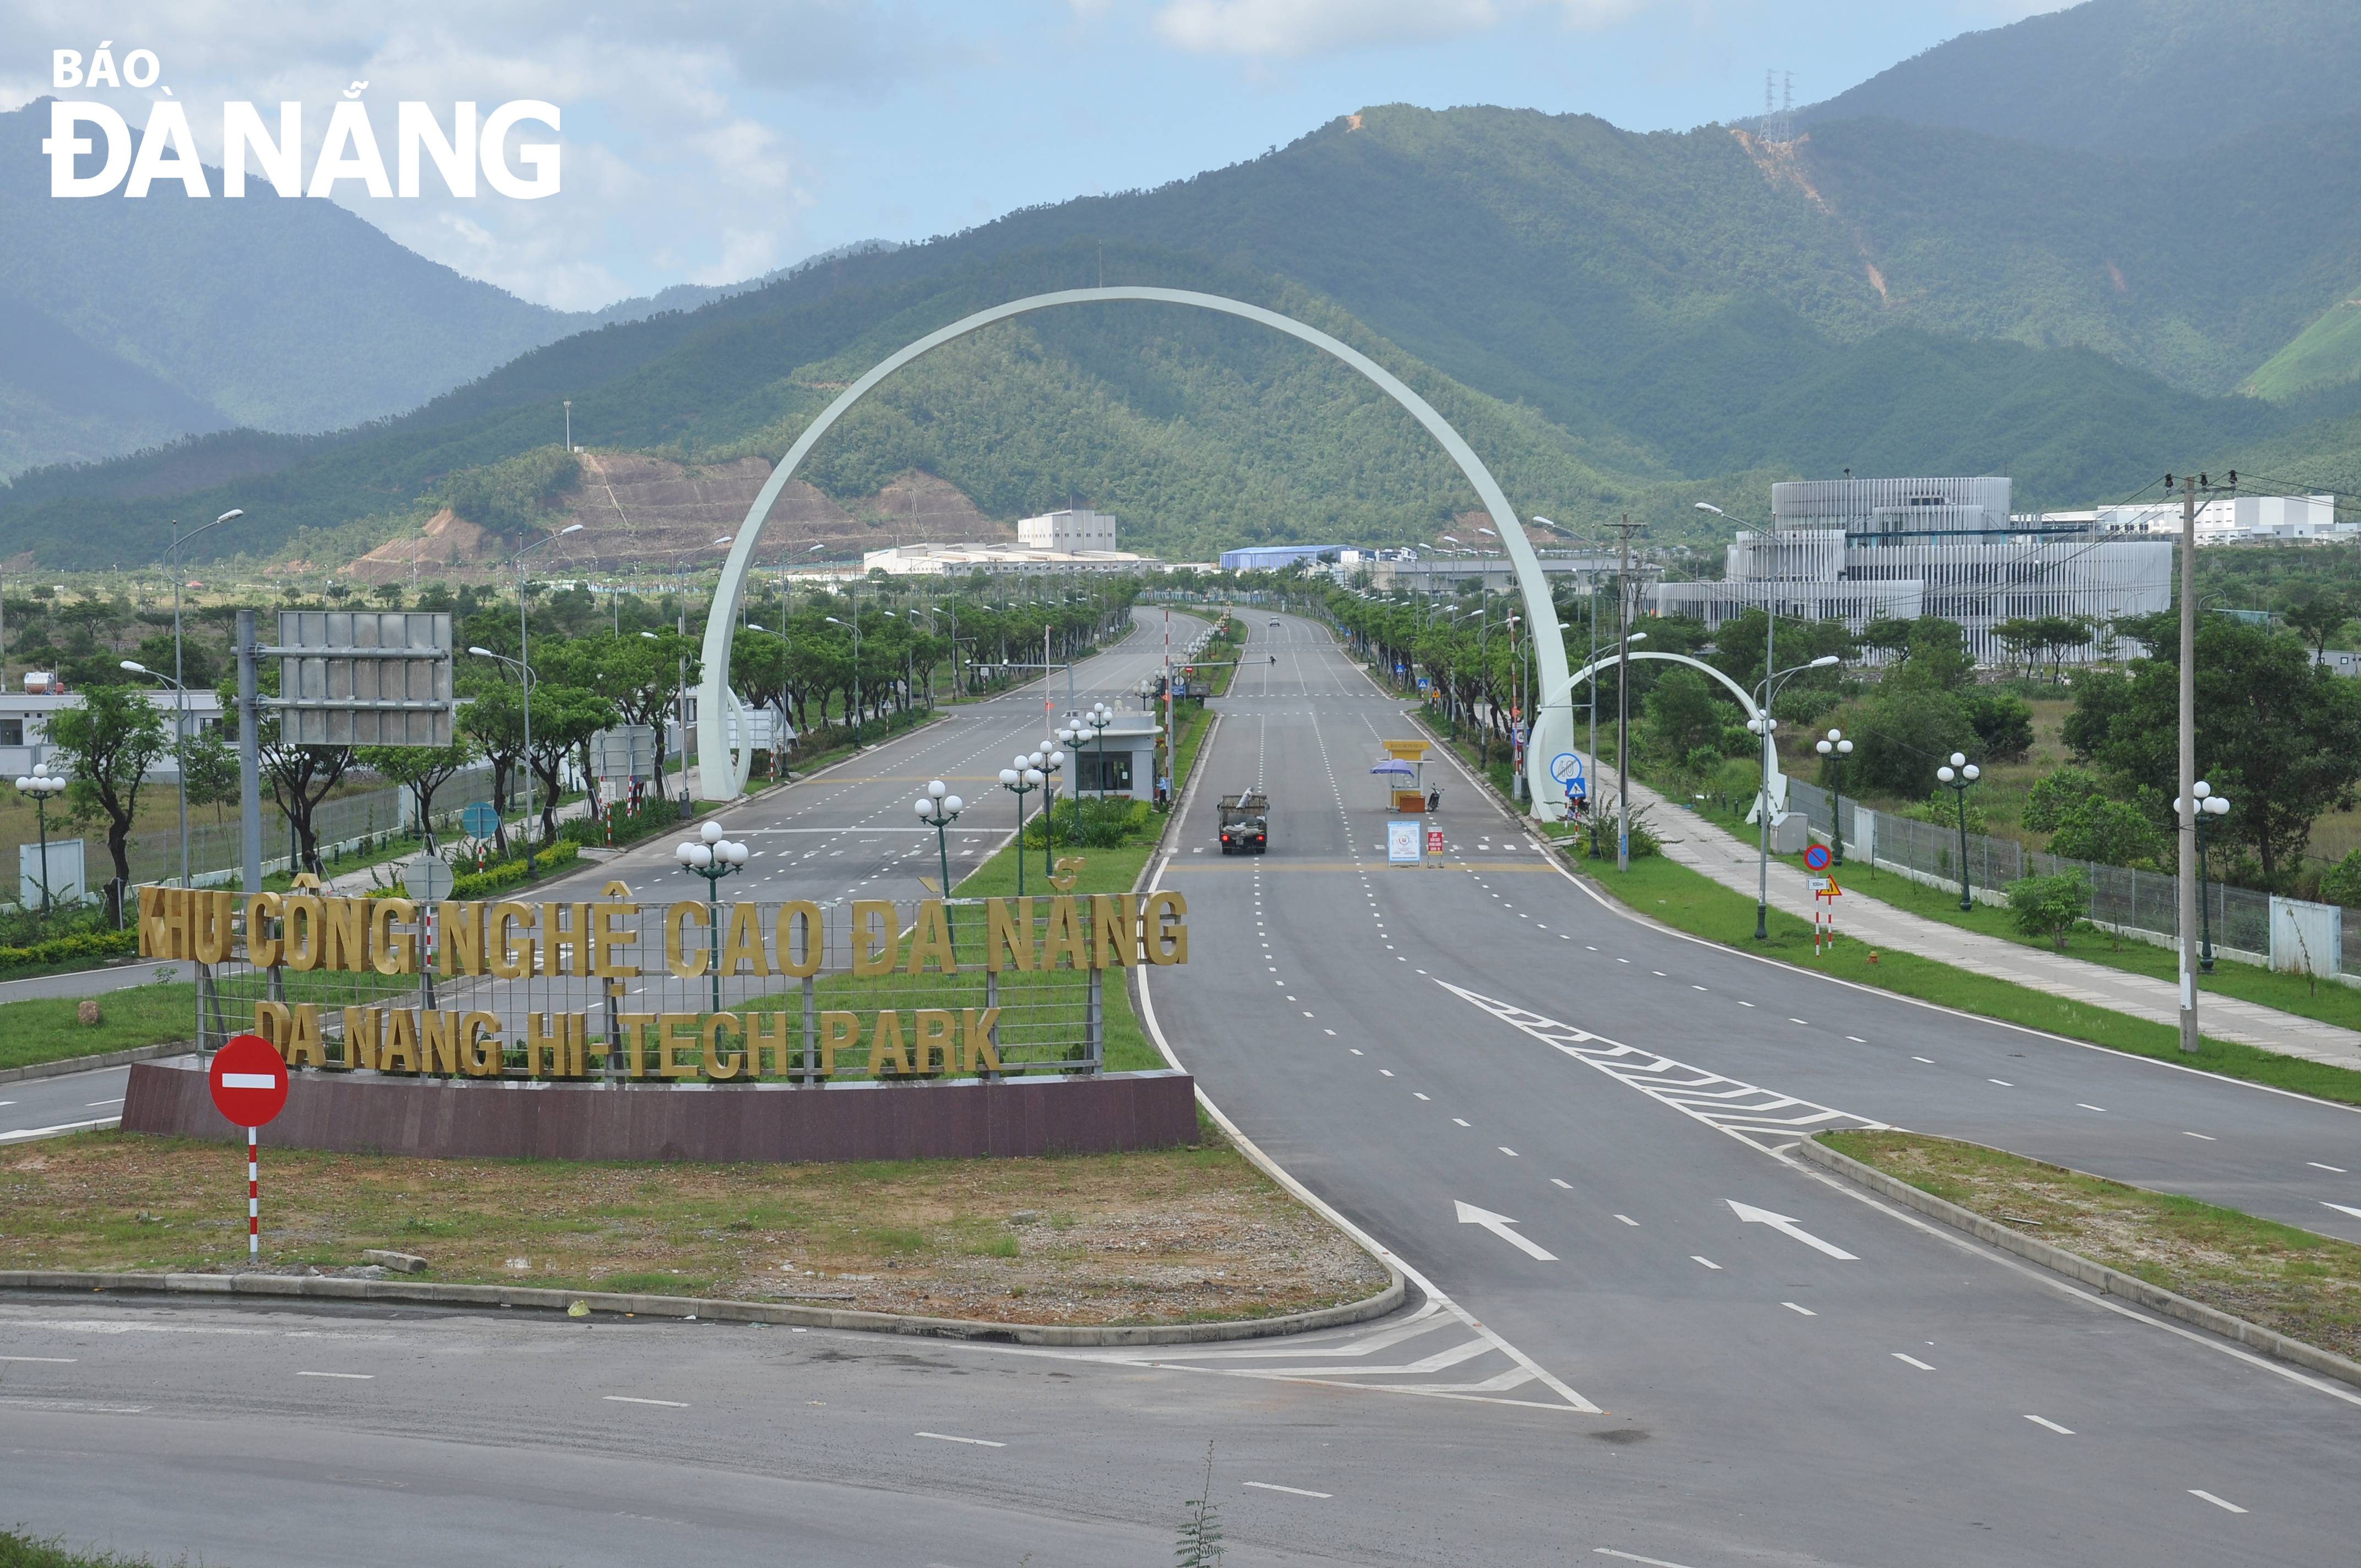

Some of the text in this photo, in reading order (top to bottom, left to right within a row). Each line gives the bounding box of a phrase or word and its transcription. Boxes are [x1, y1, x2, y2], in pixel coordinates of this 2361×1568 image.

[1557, 760, 1574, 777] 40
[139, 857, 1188, 997] KHU CÔNG NGHỆ CAO ĐÀ NẴNG
[254, 1001, 1002, 1079] DA NANG HI-TECH PARK
